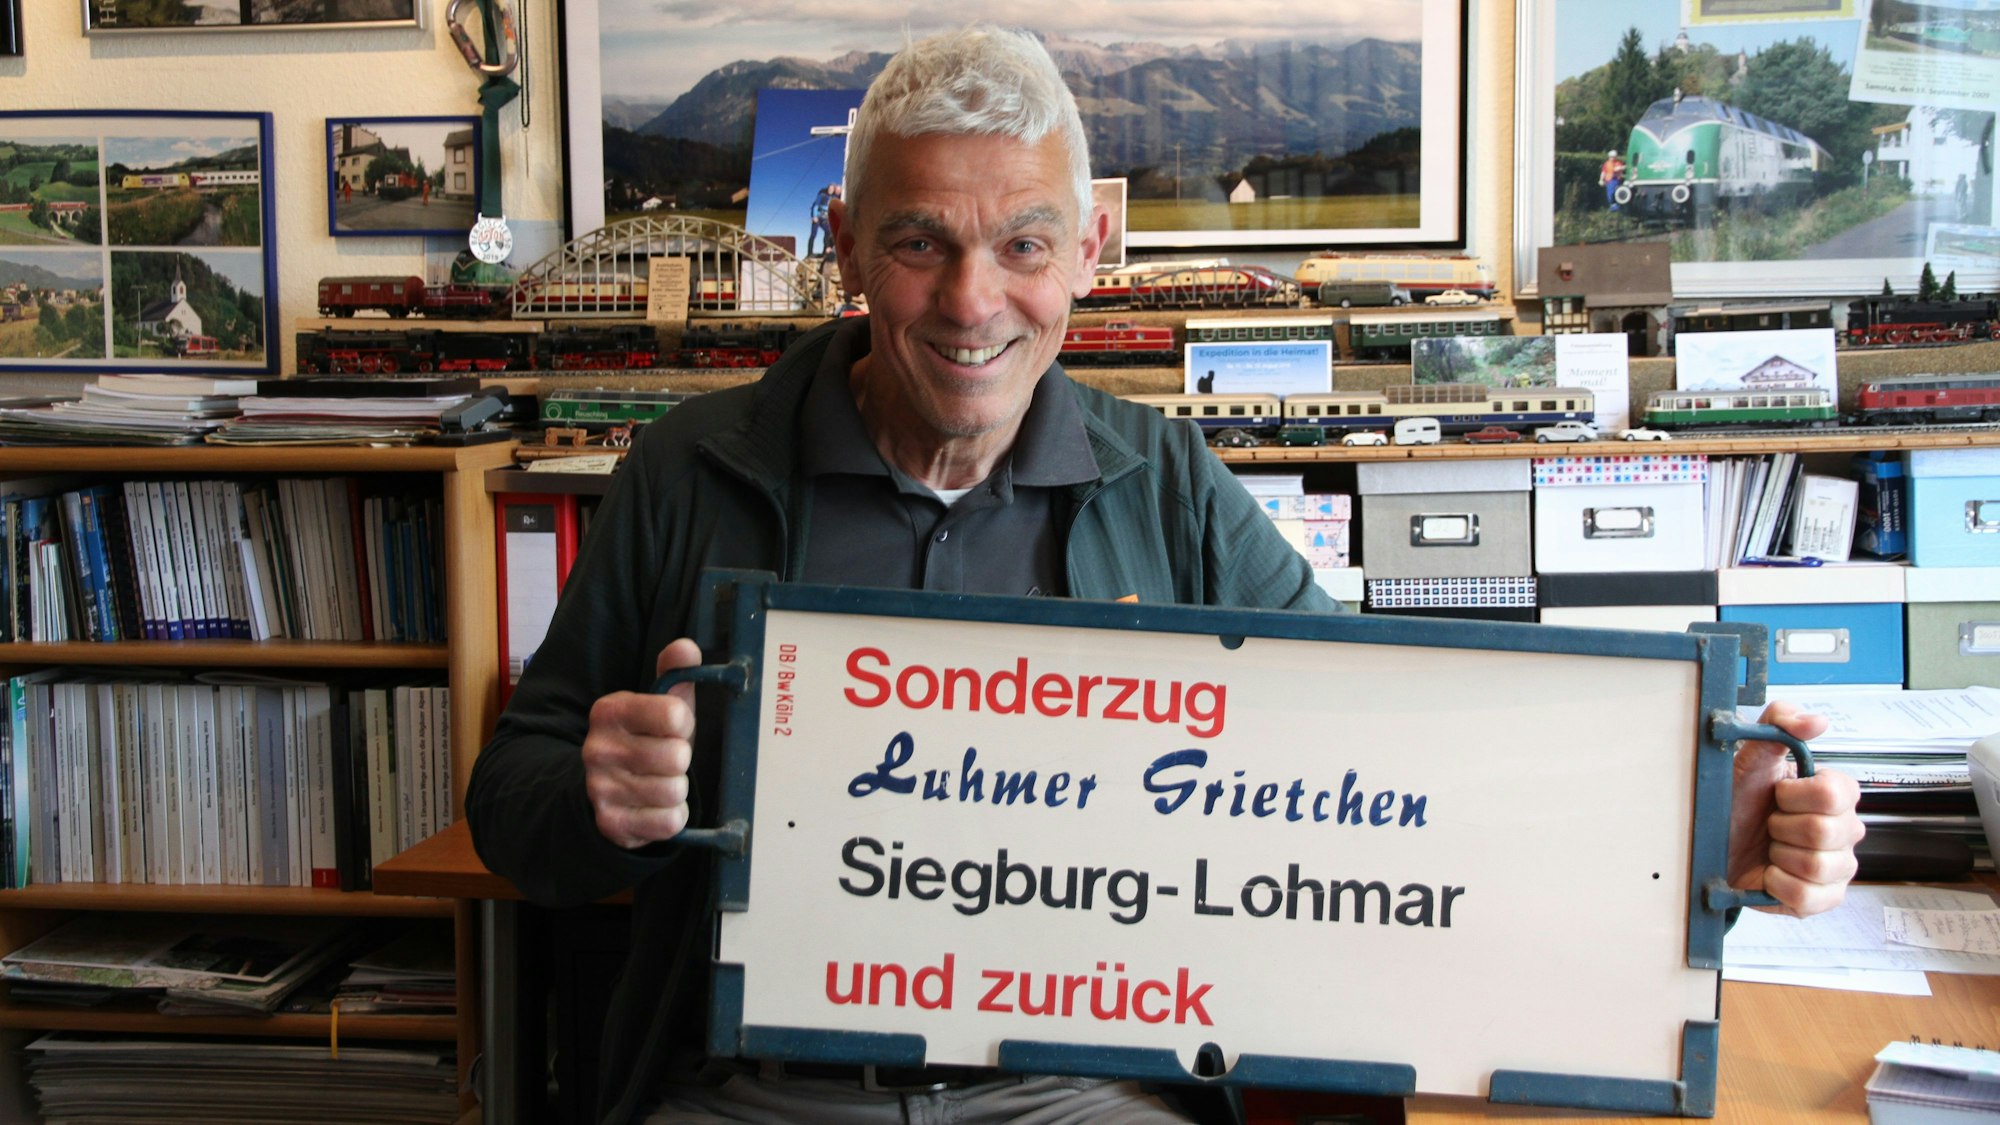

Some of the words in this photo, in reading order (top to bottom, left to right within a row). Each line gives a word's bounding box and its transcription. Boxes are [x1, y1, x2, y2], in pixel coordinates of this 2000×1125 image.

[1199, 348, 1249, 359] Expedition
[1252, 348, 1261, 356] in
[1264, 348, 1278, 356] die
[1281, 347, 1319, 356] Heimat!
[1567, 367, 1618, 377] Moment
[417, 690, 426, 710] Alpen
[438, 690, 447, 710] Alpen
[844, 646, 1228, 738] Sonderzug
[775, 694, 794, 724] Köln
[775, 726, 792, 737] 2
[439, 739, 447, 750] die
[418, 750, 426, 770] durch
[440, 750, 448, 770] durch
[419, 771, 428, 790] Wege
[440, 771, 449, 790] Wege
[848, 730, 1098, 812] Luhmer
[1142, 748, 1430, 828] Grietchen
[825, 952, 956, 1012] und
[977, 961, 1215, 1026] zurück
